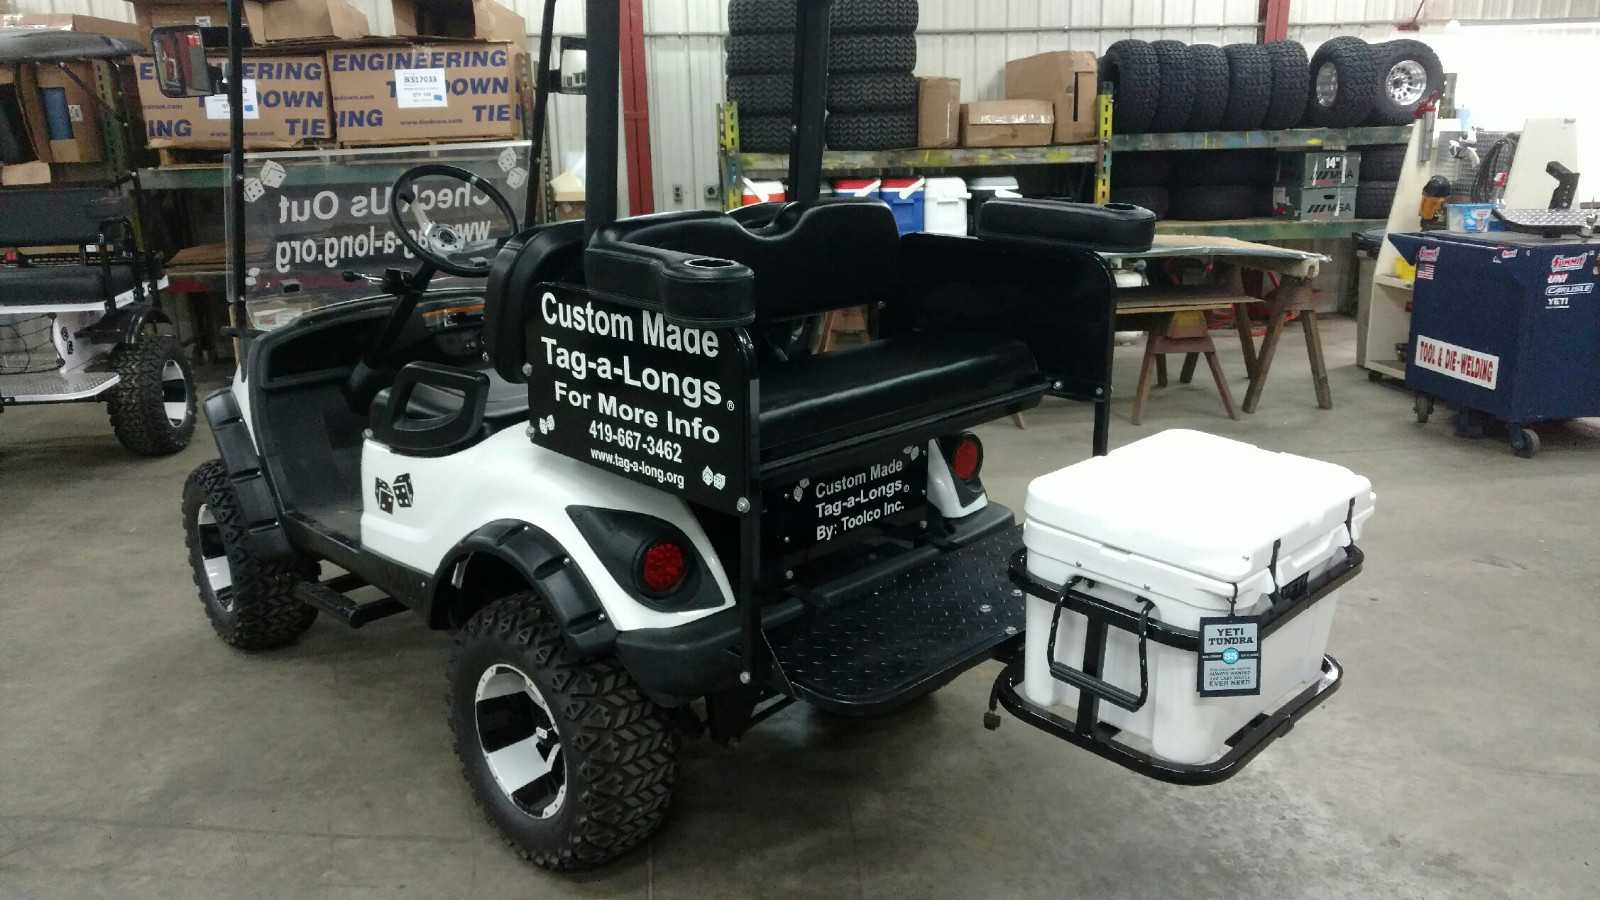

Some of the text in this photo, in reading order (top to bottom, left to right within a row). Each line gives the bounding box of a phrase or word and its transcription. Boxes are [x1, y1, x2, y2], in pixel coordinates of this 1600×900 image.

[333, 50, 506, 72] ENGINEERING
[140, 62, 322, 81] EERING
[334, 109, 384, 128] ING
[472, 104, 511, 122] TIE
[148, 119, 192, 137] ING
[285, 118, 325, 136] TIE
[1330, 170, 1354, 179] MA
[1548, 297, 1569, 305] YETI
[541, 291, 719, 358] Custom Made
[1420, 340, 1494, 383] TOOL & DIE-WELDING
[554, 380, 720, 444] For More Info
[588, 419, 683, 464] 419-667-3462
[590, 447, 685, 490] www.tag-a-long.org
[815, 458, 903, 499] Custom Made
[816, 500, 905, 541] By: Toolco Inc.
[1208, 636, 1254, 646] TUNDRA
[1216, 627, 1244, 636] YETI
[1224, 652, 1238, 661] 35
